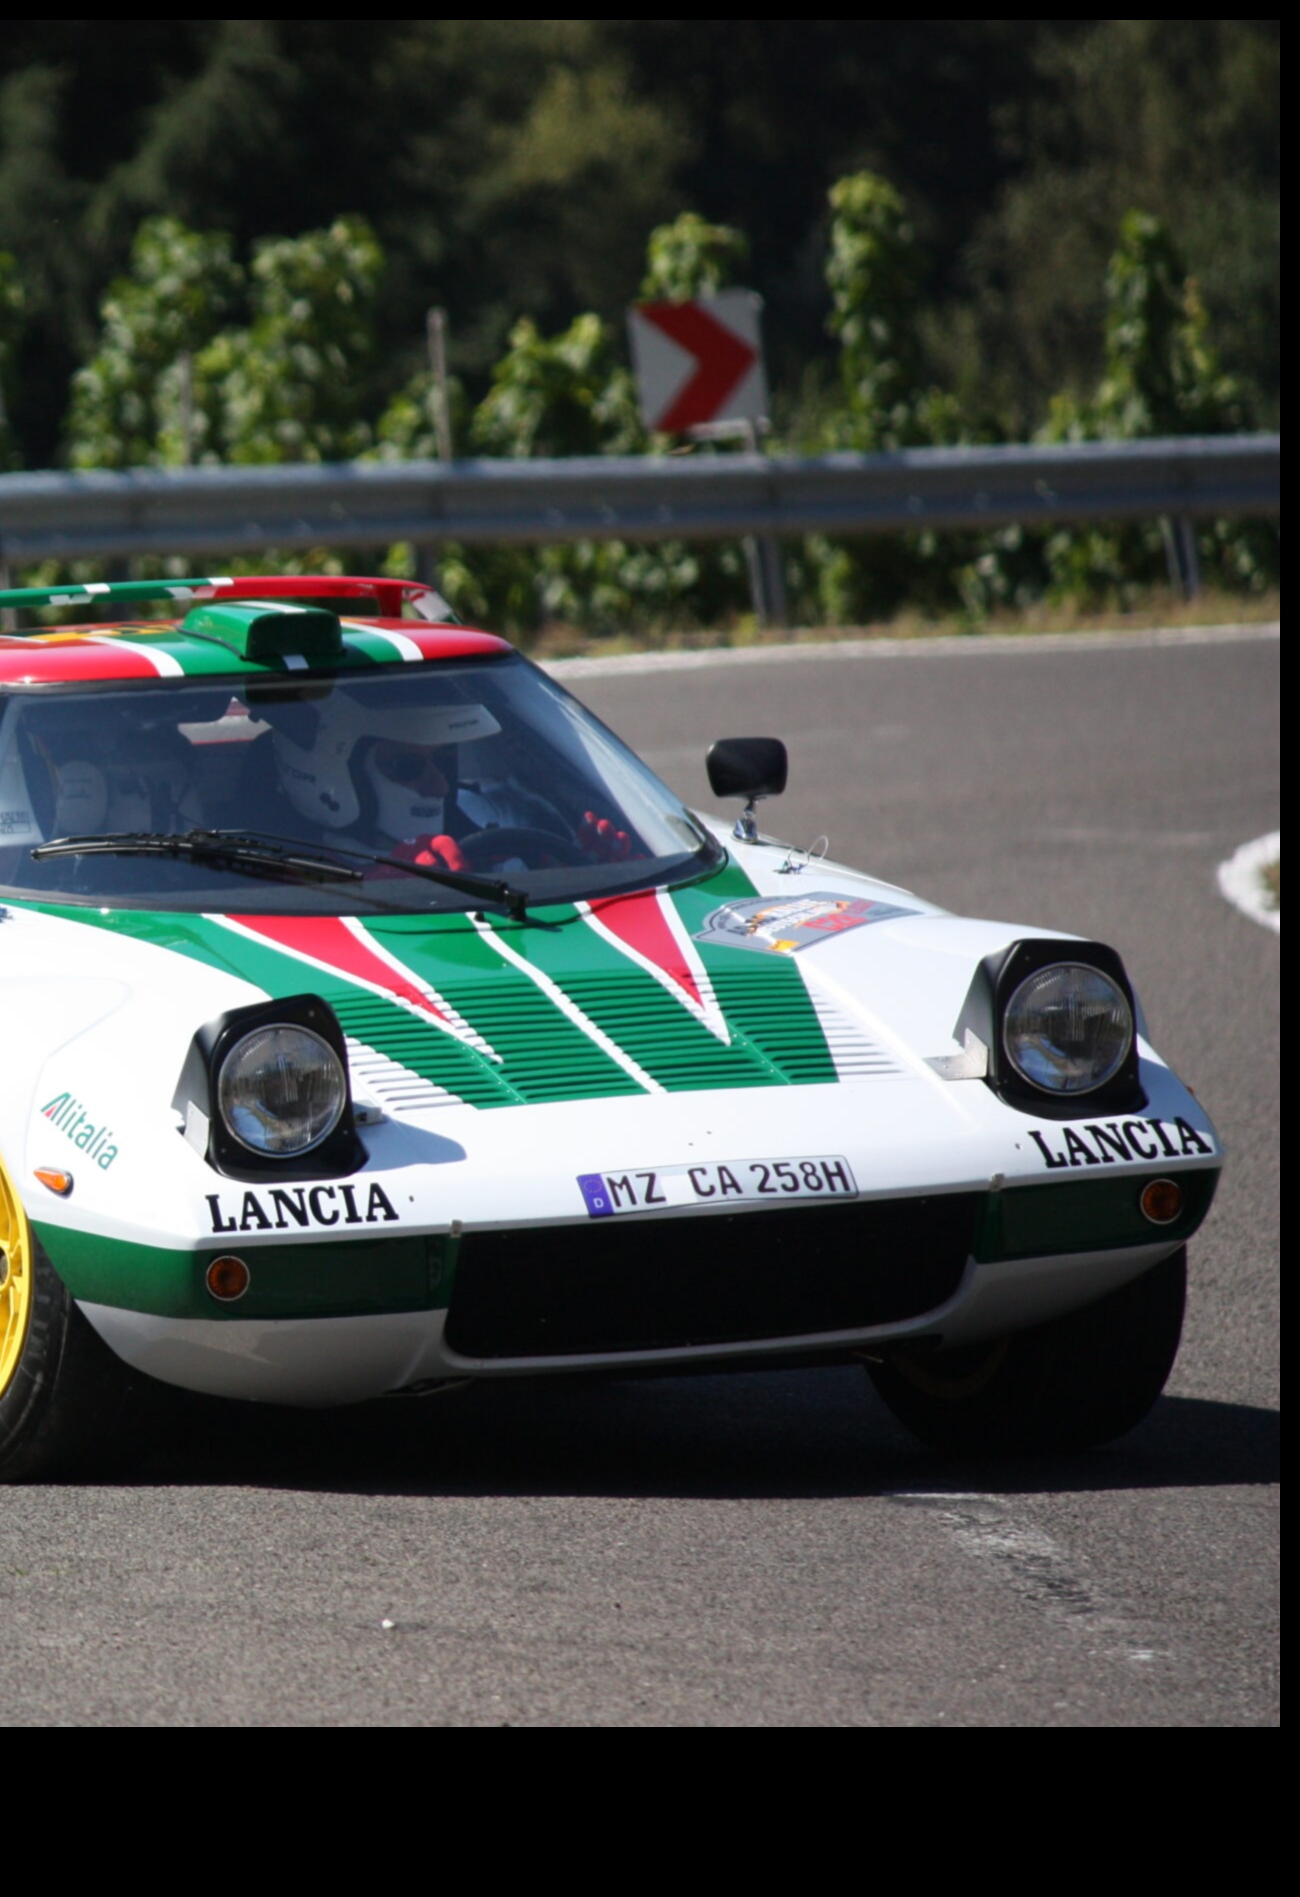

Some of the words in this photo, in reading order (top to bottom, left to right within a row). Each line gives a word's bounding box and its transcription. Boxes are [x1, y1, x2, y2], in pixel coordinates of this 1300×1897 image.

[40, 1091, 119, 1171] Alitalia
[1027, 1116, 1214, 1169] LANCIA
[205, 1182, 400, 1234] LANCIA
[593, 1196, 605, 1209] D
[606, 1172, 667, 1208] MZ
[687, 1165, 744, 1197] CA
[748, 1160, 851, 1194] 258H
